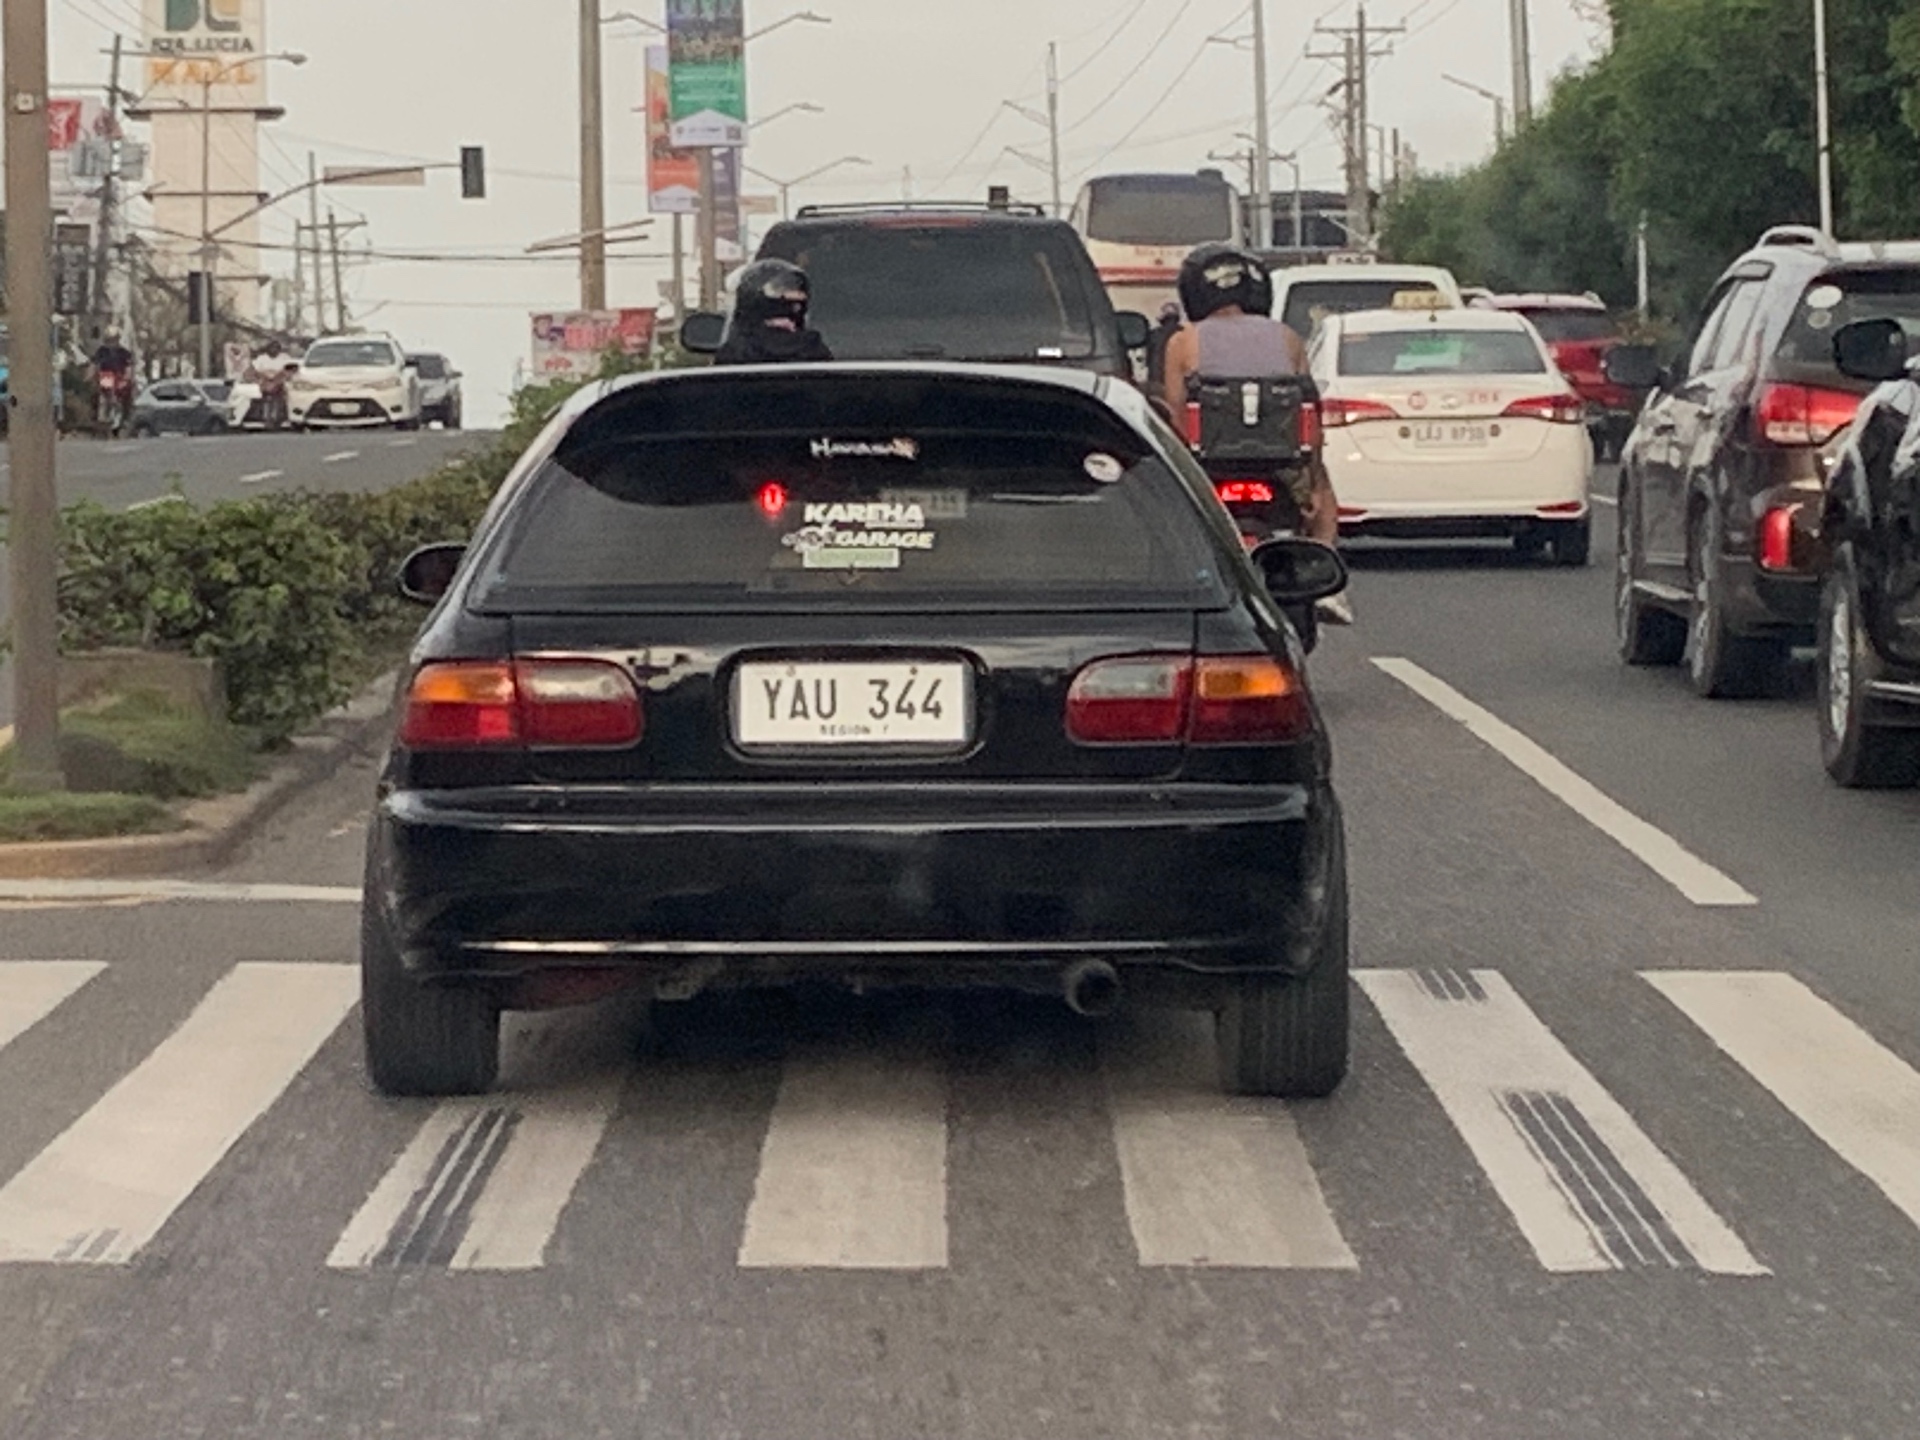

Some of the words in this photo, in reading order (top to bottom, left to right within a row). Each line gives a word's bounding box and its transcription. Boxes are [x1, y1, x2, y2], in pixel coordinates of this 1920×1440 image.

[195, 38, 254, 52] LUCIA
[835, 531, 935, 548] GARAGE
[763, 679, 837, 721] YAU
[868, 679, 943, 721] 344
[820, 724, 871, 736] REGION
